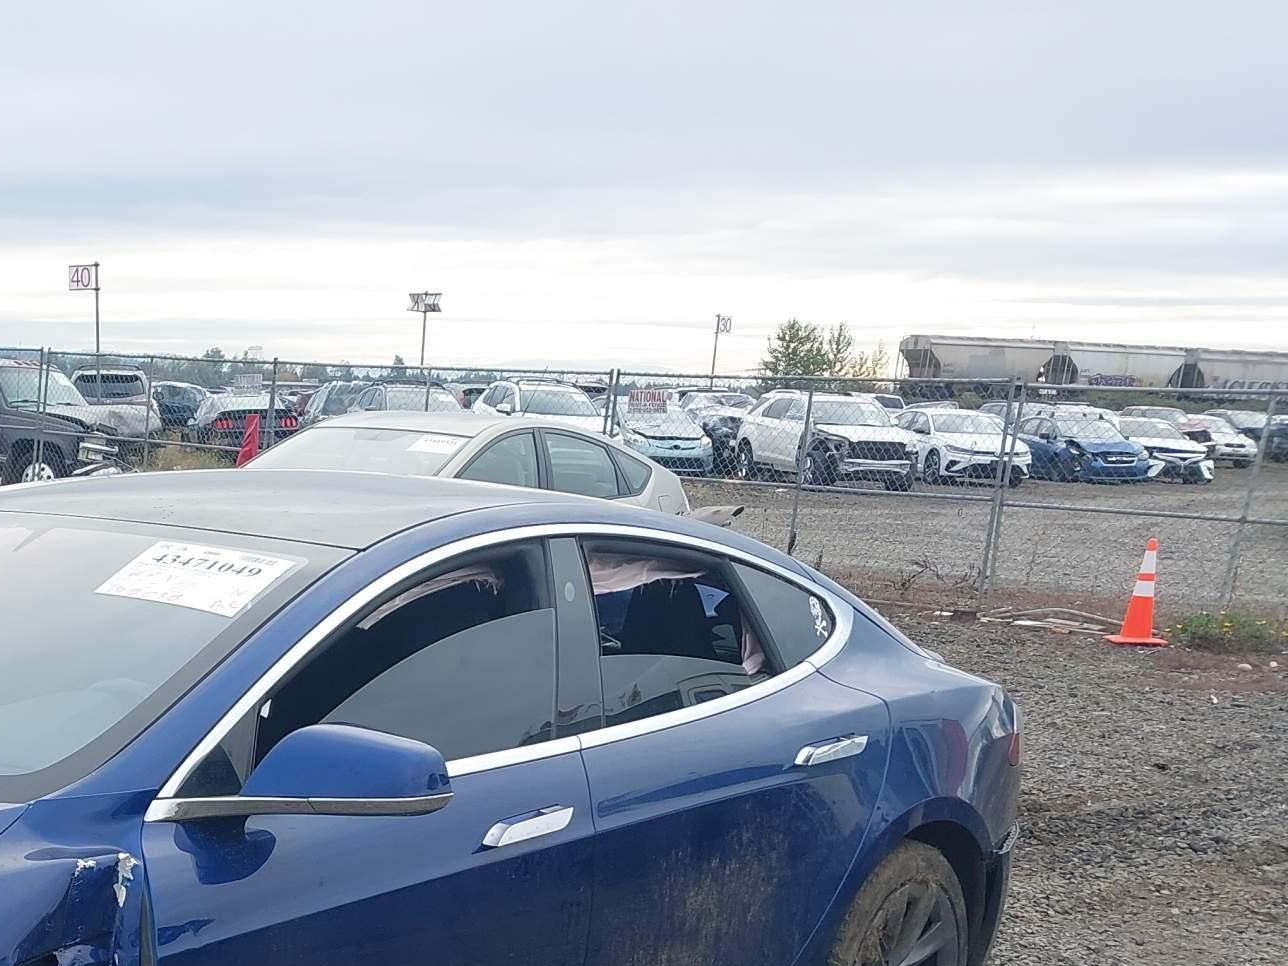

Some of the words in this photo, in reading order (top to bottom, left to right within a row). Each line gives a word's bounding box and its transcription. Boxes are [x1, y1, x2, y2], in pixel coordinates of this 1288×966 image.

[71, 267, 91, 288] 40
[720, 317, 732, 332] 30
[629, 390, 667, 402] NATIONAL
[152, 552, 263, 578] 43471049
